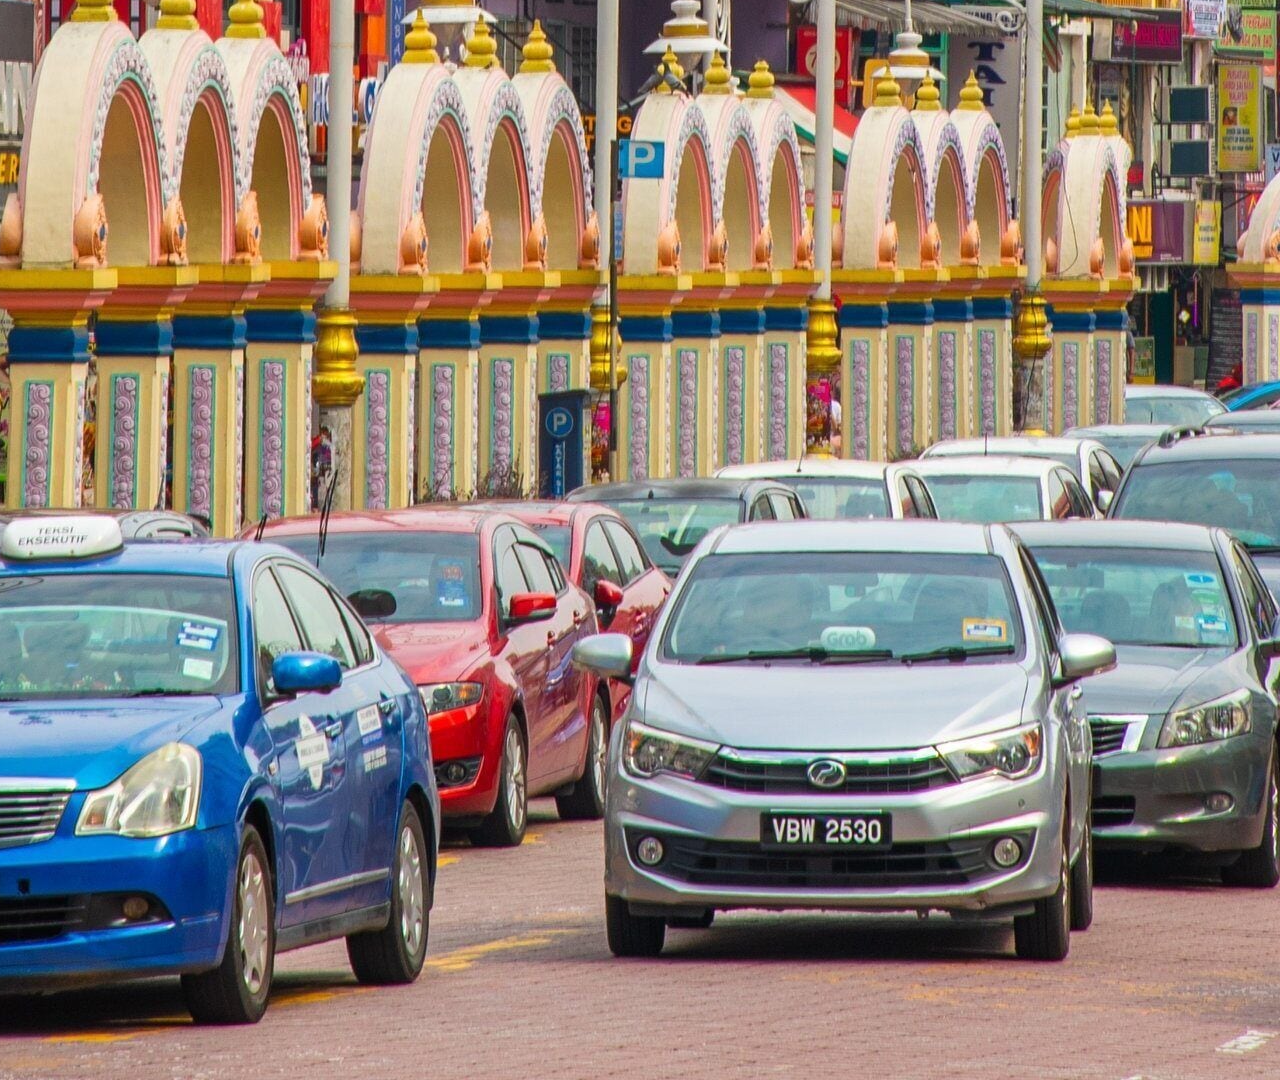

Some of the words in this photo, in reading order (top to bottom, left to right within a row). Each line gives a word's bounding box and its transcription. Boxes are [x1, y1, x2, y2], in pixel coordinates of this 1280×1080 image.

[628, 142, 656, 177] P
[553, 413, 567, 432] P
[38, 526, 74, 535] TEKSI
[18, 535, 88, 546] EKSEKUTIF
[827, 630, 868, 647] Grab
[772, 817, 816, 844] VBW
[825, 818, 882, 844] 2530
